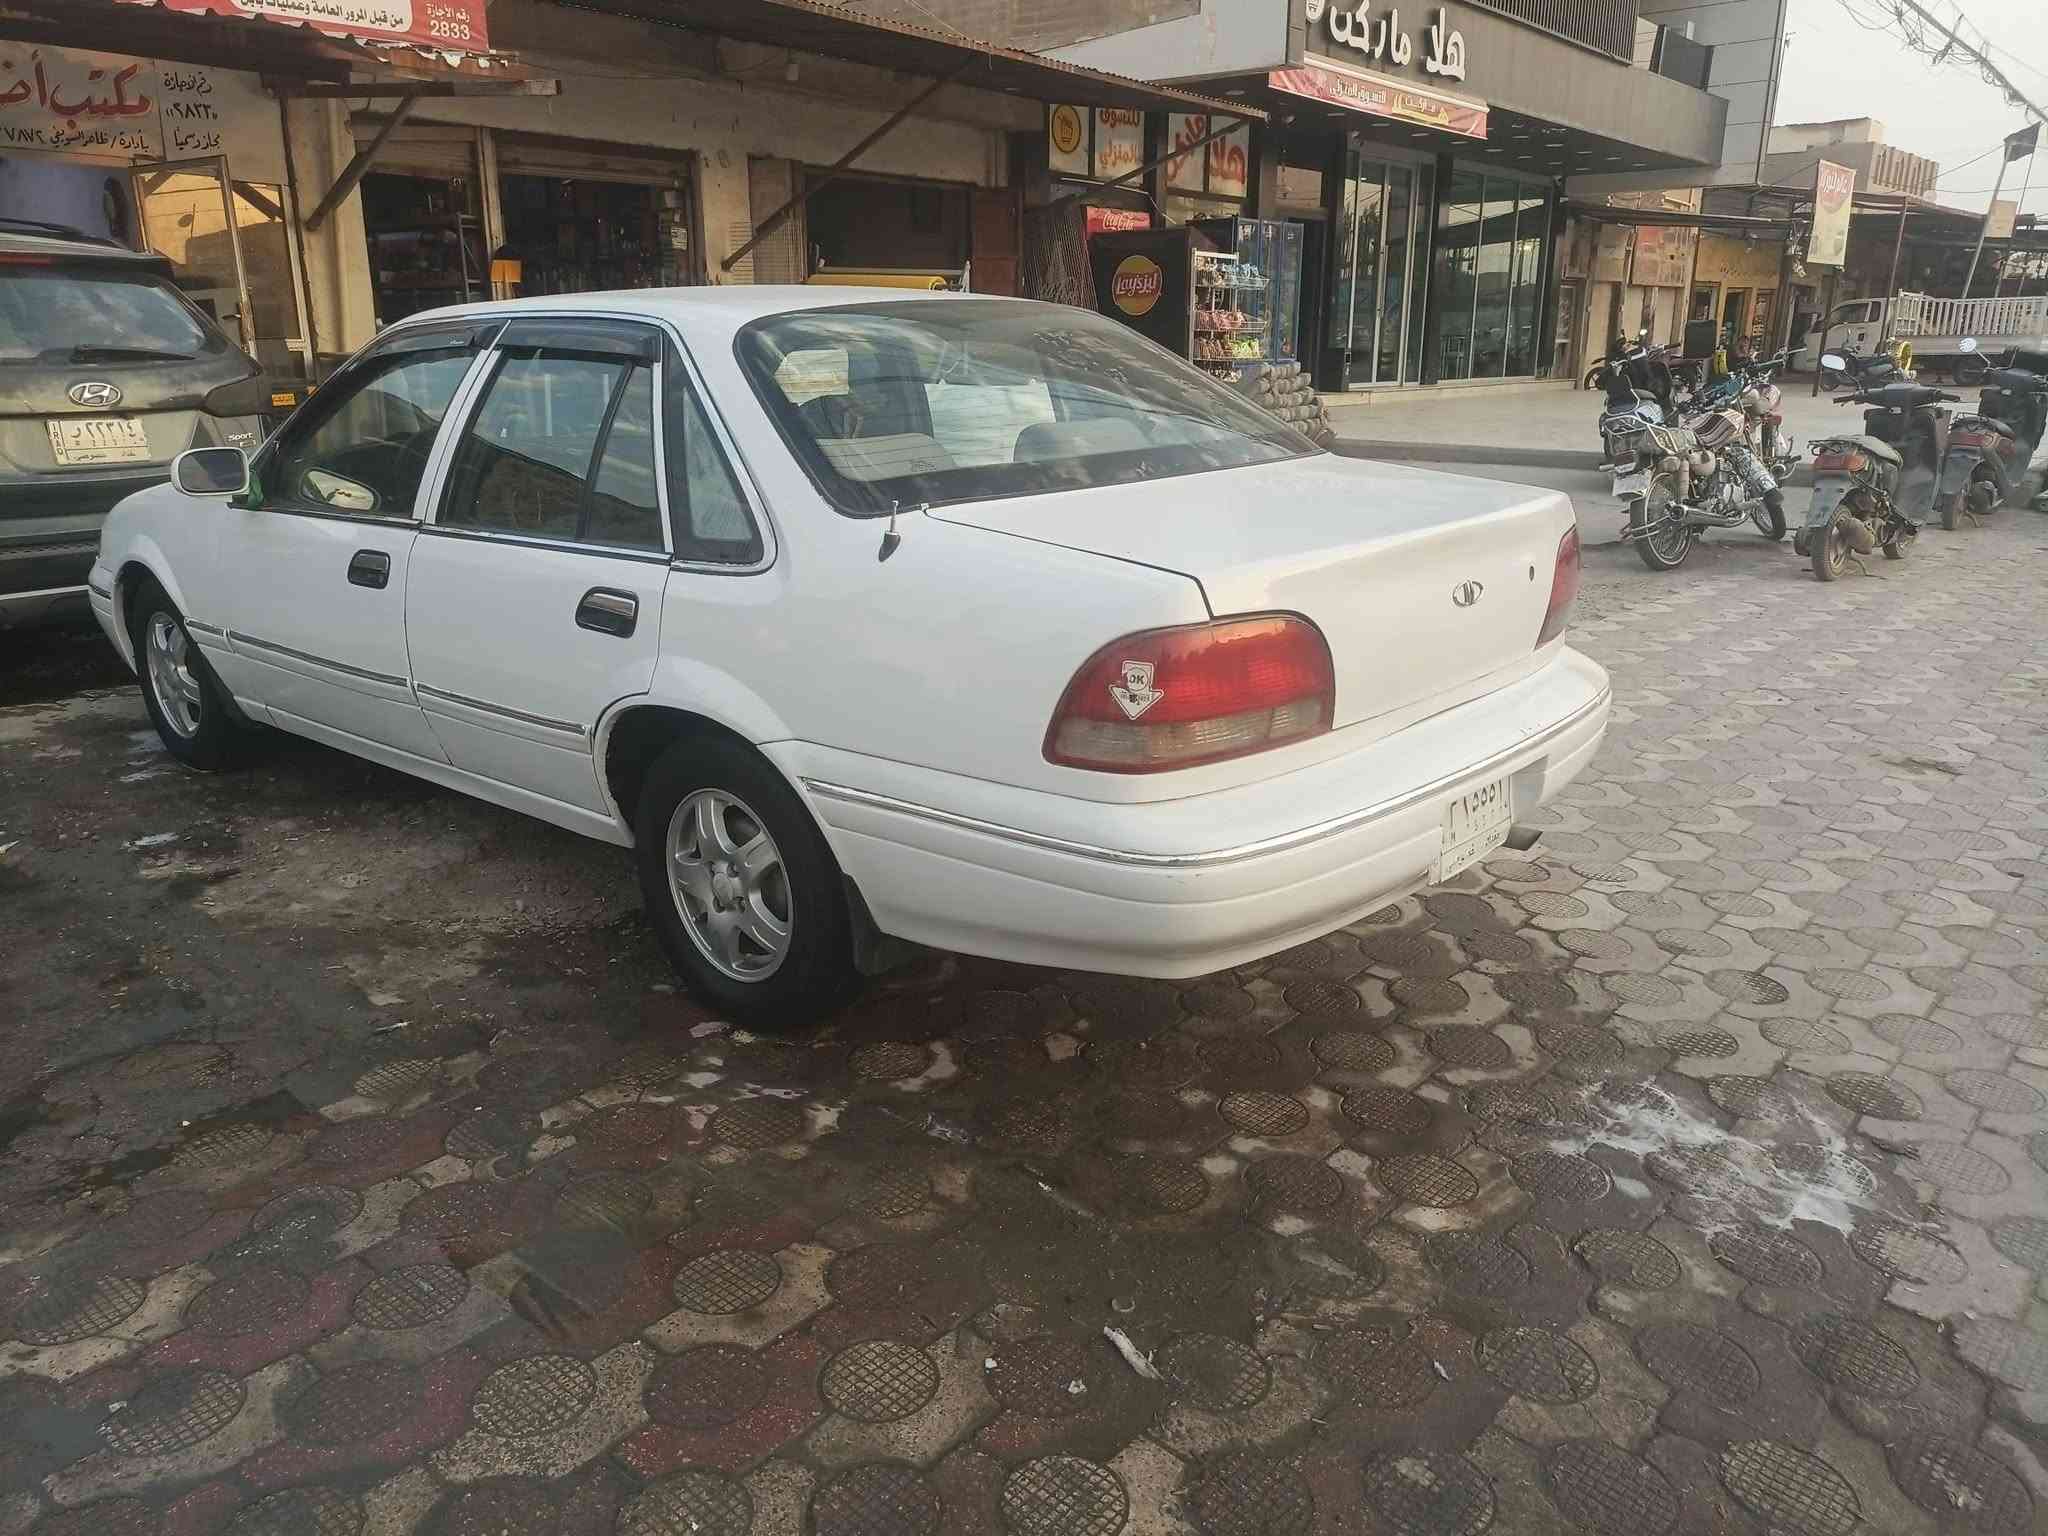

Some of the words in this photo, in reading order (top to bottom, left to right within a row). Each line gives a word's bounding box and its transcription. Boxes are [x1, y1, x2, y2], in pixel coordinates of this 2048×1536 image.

[369, 10, 388, 25] قبل
[389, 15, 404, 28] من
[429, 20, 471, 41] 2833
[1426, 7, 1466, 82] هلا
[49, 63, 152, 129] مكتب
